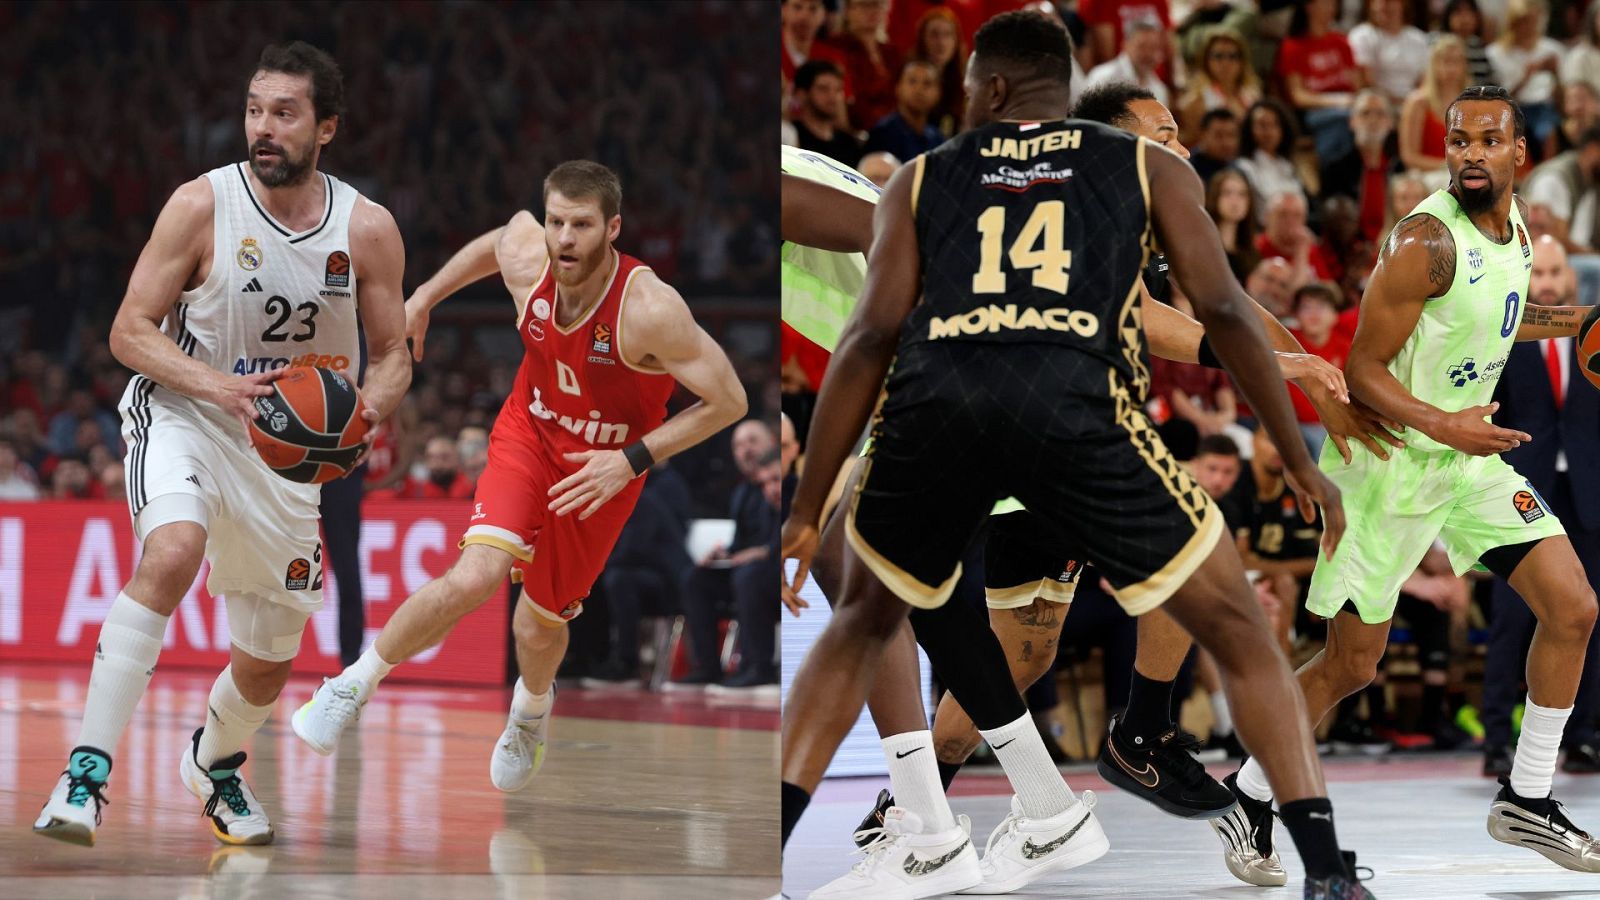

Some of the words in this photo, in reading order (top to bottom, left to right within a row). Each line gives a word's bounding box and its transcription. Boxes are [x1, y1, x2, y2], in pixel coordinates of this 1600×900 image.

[980, 130, 1082, 161] JAITEH
[973, 199, 1072, 295] 14
[261, 295, 319, 342] 23
[928, 304, 1099, 340] MONACO
[1500, 290, 1519, 339] 0
[556, 360, 581, 397] 0
[529, 386, 630, 445] bwin
